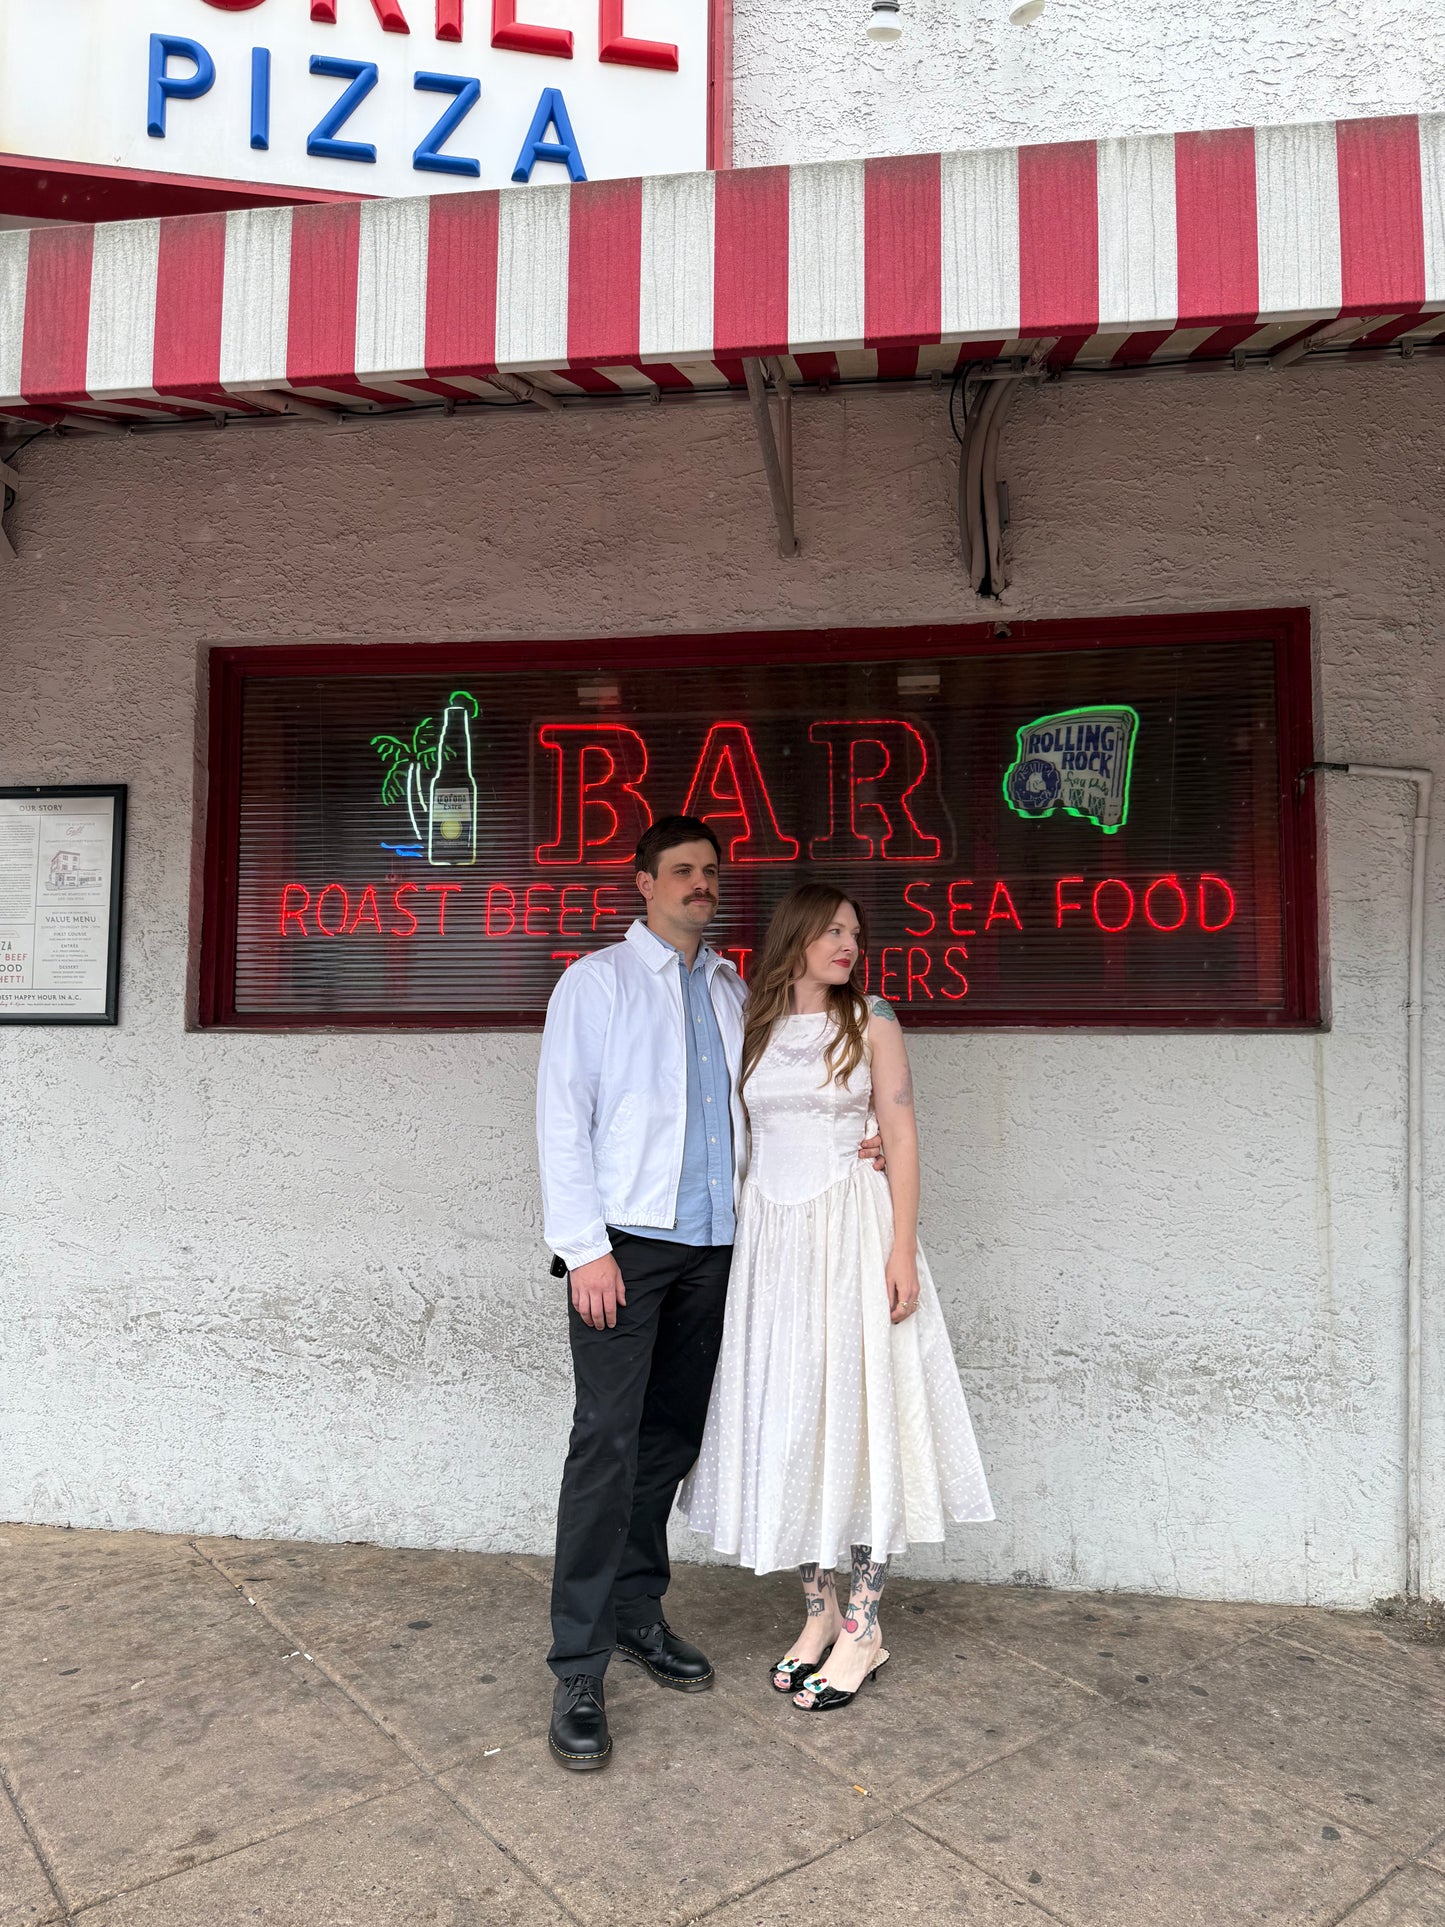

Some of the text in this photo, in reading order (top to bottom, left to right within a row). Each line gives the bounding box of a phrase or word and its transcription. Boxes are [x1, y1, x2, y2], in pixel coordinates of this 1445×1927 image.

[147, 32, 587, 182] PIZZA
[1028, 724, 1115, 754] ROLLING
[1061, 751, 1113, 779] ROCK
[19, 804, 37, 812] OUR
[535, 720, 941, 865] BAR
[279, 883, 619, 937] ROAST BEEF
[903, 873, 1235, 937] SEA FOOD
[5, 953, 28, 961] BEEF
